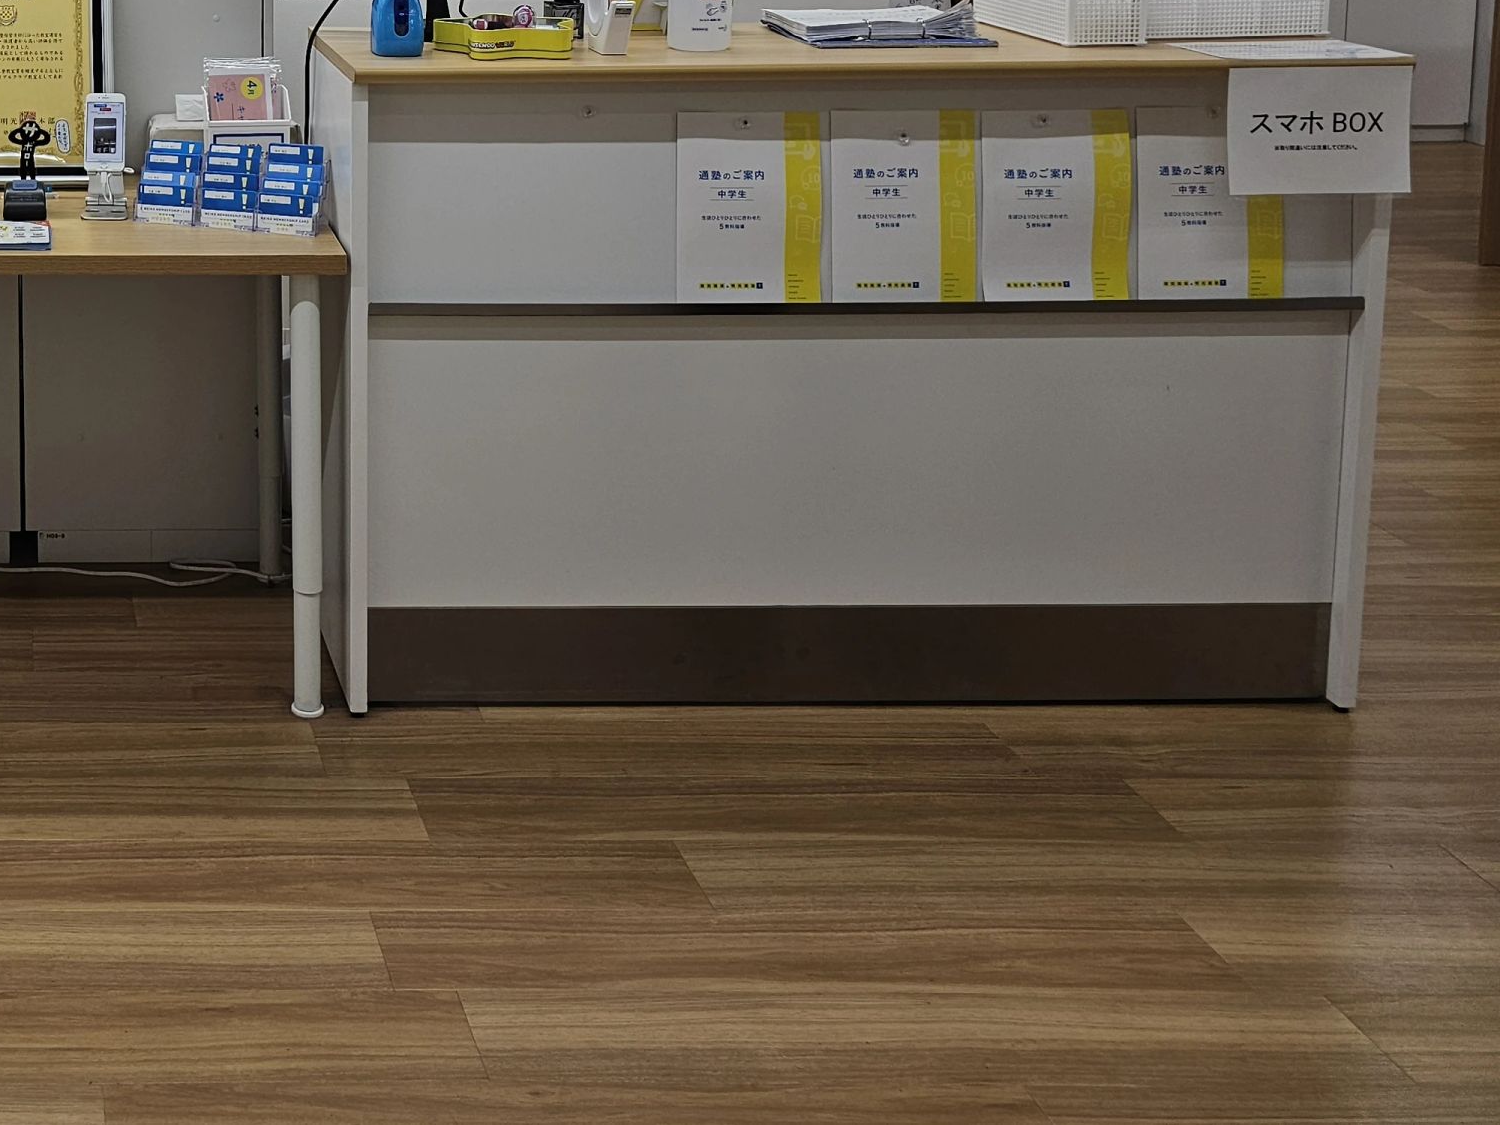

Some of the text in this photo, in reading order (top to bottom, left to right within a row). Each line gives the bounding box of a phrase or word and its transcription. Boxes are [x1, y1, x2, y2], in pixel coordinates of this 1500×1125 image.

[1250, 111, 1384, 134] スマホ BOX
[699, 170, 765, 181] 通塾のご案内
[853, 168, 919, 179] 通塾のご案内
[1004, 168, 1073, 179] 通塾のご案内
[1159, 165, 1225, 176] 通塾のご案内
[718, 190, 747, 199] 中学生
[872, 188, 901, 197] 中学生
[1024, 189, 1054, 198] 中学生
[1178, 185, 1207, 194] 中学生
